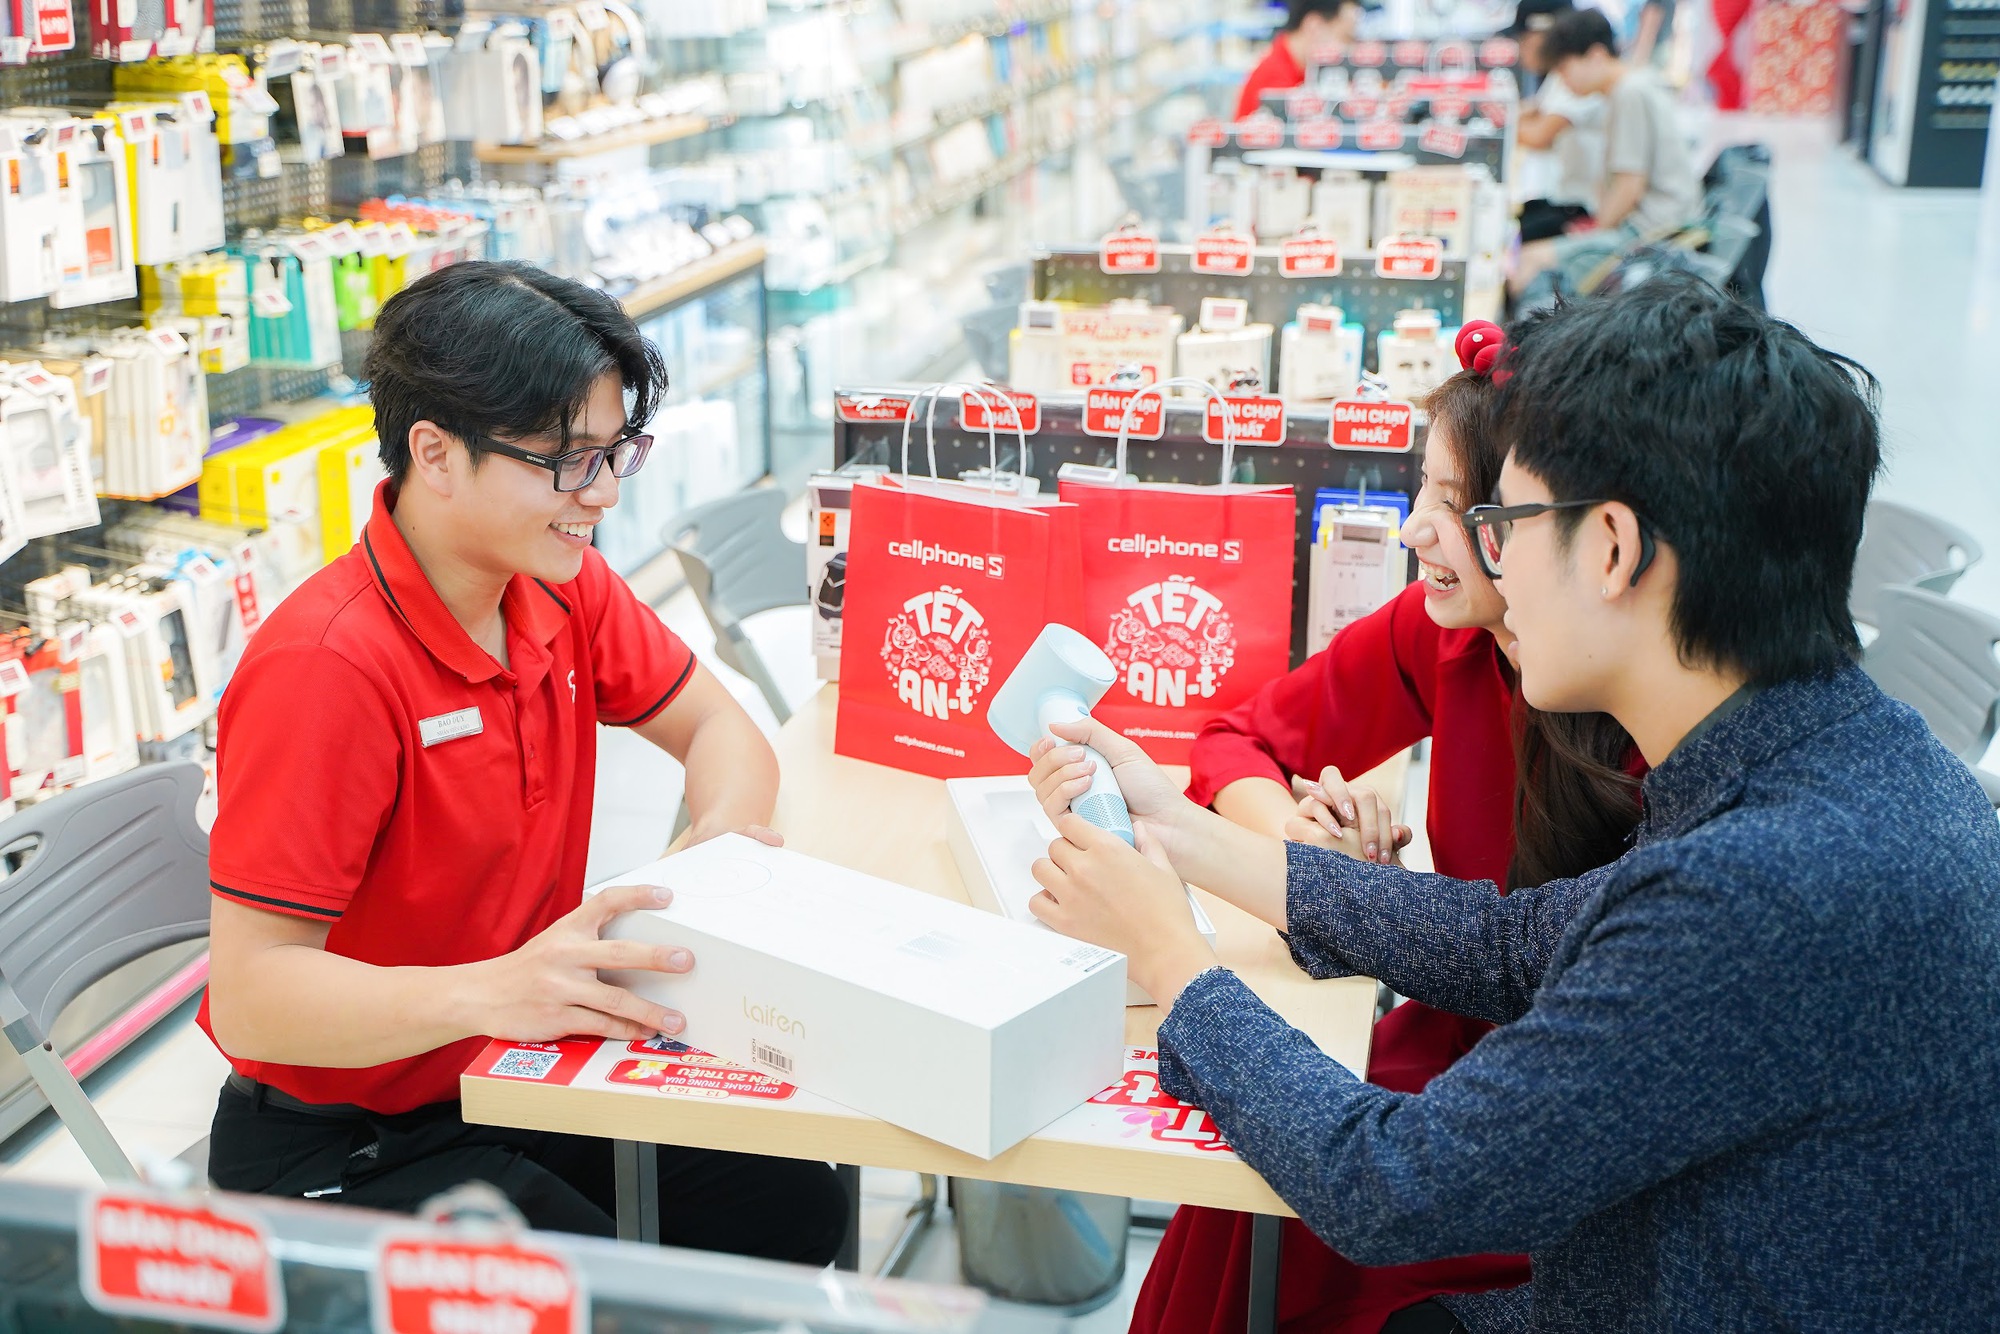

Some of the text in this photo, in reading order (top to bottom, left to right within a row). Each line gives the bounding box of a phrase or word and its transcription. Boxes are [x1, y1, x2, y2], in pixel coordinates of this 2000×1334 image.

[1089, 392, 1120, 410] BÁN
[1209, 401, 1282, 422] BN CHẠY
[1335, 405, 1409, 428] BÁN CHẠY
[1350, 426, 1393, 443] NHẤT
[1126, 574, 1224, 631] TẾT
[903, 584, 985, 644] TẾT
[894, 734, 966, 758] cellphones.com.vn
[743, 995, 806, 1040] laifen
[677, 1067, 724, 1080] TRIỆU
[727, 1072, 748, 1081] 20
[722, 1082, 752, 1092] GAME
